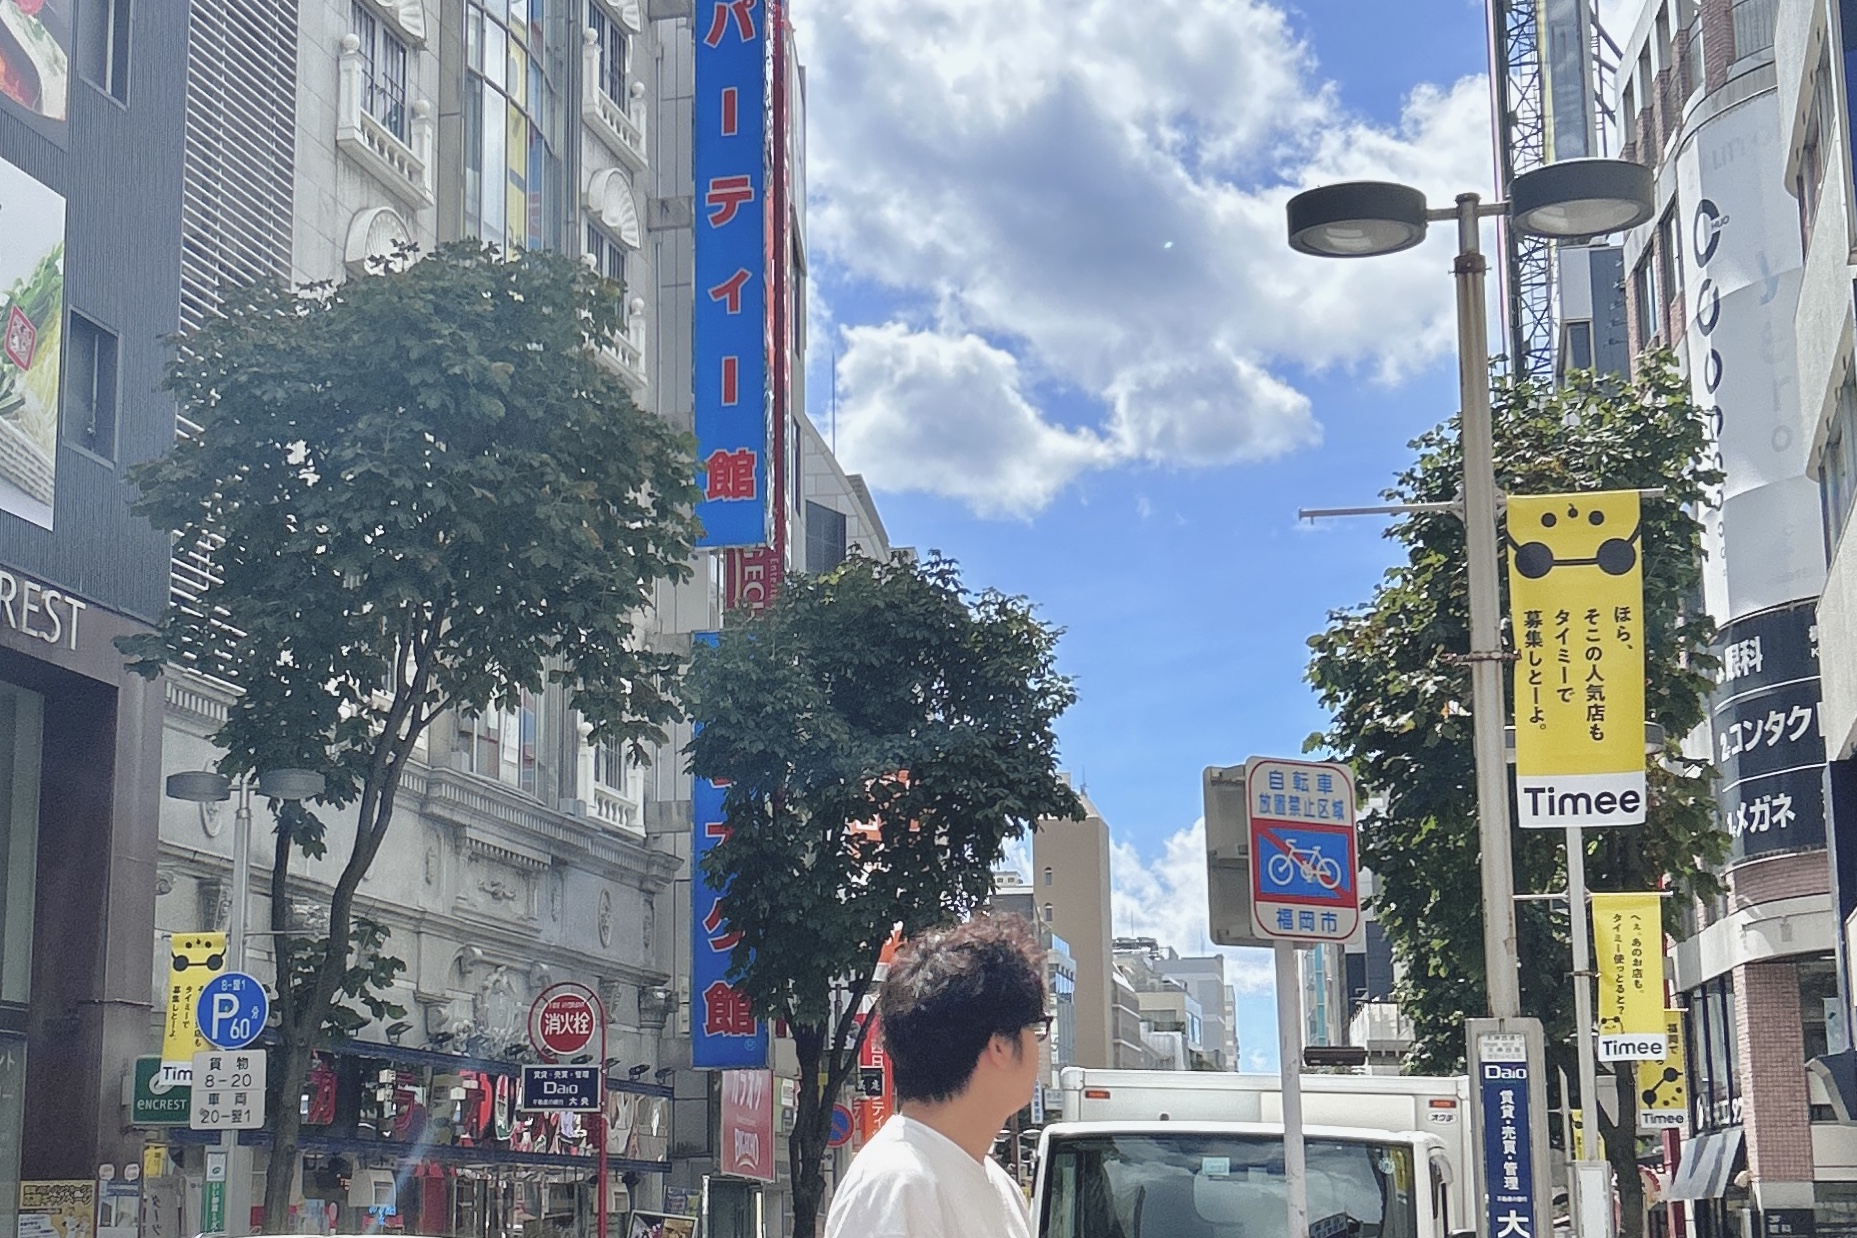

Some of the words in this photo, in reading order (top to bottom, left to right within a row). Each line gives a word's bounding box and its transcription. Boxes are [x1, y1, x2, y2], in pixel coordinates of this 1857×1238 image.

[1613, 606, 1634, 650] ほら、
[1554, 609, 1576, 704] タイミーで
[1523, 610, 1547, 731] 募集しとーよ。
[1583, 608, 1606, 742] そこの人気店も
[1268, 769, 1335, 795] 自転車
[1258, 793, 1345, 820] 放置禁止区域
[1523, 786, 1641, 817] Timee
[1276, 907, 1338, 934] 福岡市
[211, 993, 240, 1040] P
[230, 1017, 250, 1039] 60
[544, 1011, 591, 1036] 消火栓
[1603, 1039, 1663, 1056] Timee
[162, 1066, 193, 1081] Tim
[209, 1056, 249, 1071] 貨物
[204, 1073, 252, 1088] 8-20
[208, 1092, 248, 1107] 車両
[1642, 1113, 1684, 1124] Timee
